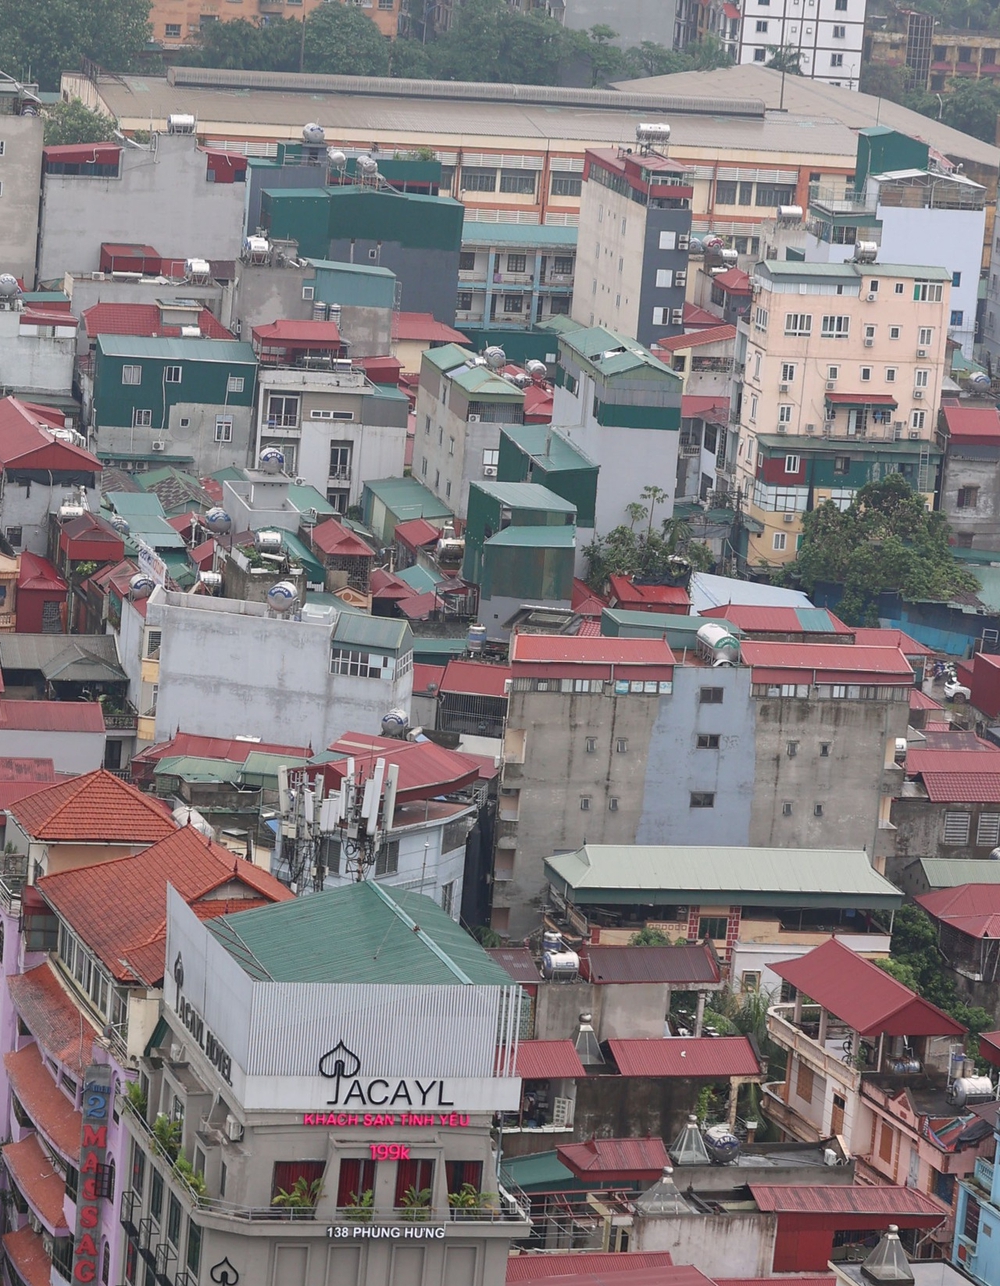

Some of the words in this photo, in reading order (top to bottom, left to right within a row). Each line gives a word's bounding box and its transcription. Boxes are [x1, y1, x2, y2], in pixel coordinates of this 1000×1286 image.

[87, 1095, 106, 1119] 2
[303, 1110, 359, 1126] KHÁCH
[362, 1113, 395, 1129] SẠN
[400, 1110, 435, 1127] TÌNH
[439, 1110, 471, 1127] YÊU
[369, 1142, 411, 1162] 199k
[326, 1226, 349, 1239] 138
[352, 1224, 401, 1239] PHÙNG
[404, 1226, 446, 1239] HƯNG
